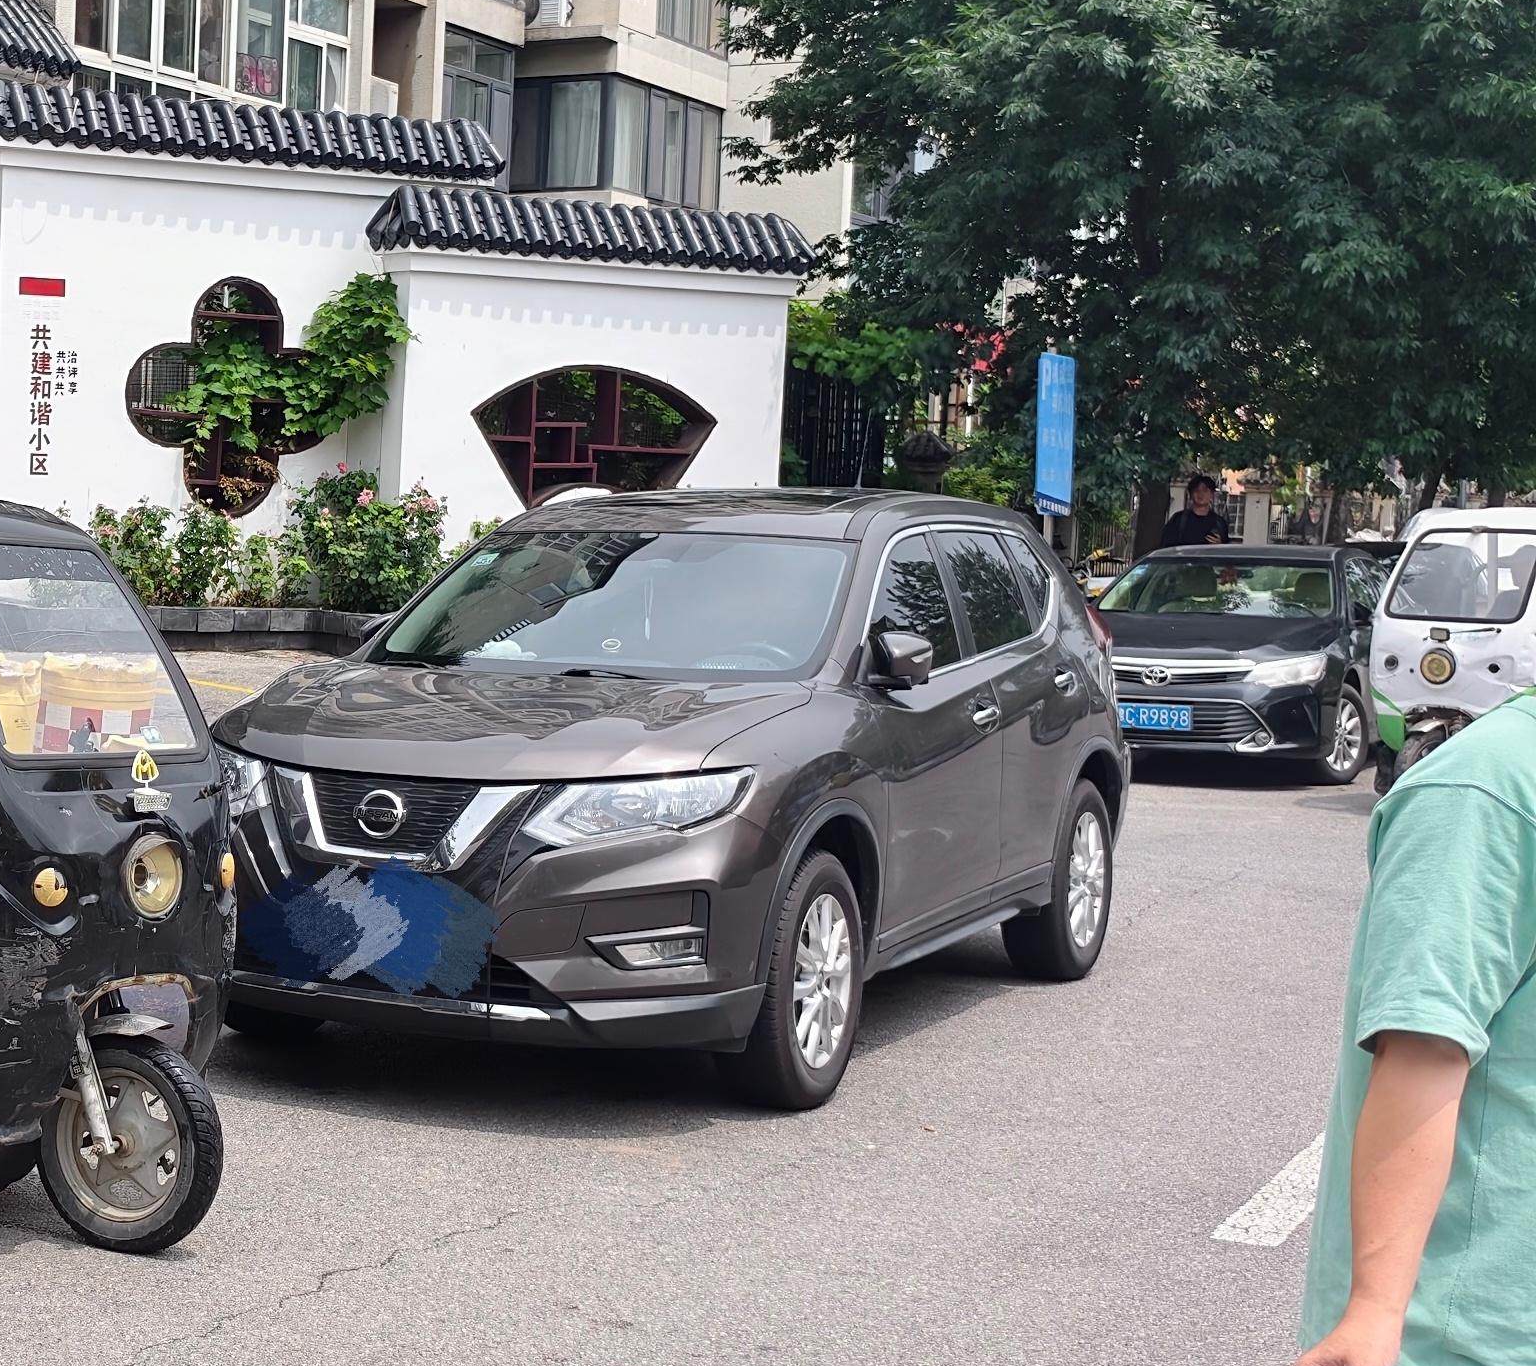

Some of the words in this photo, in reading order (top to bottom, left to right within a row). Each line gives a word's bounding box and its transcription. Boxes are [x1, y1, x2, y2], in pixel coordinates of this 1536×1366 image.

[28, 324, 52, 476] 共建和谐小区
[353, 806, 407, 823] NISSAN
